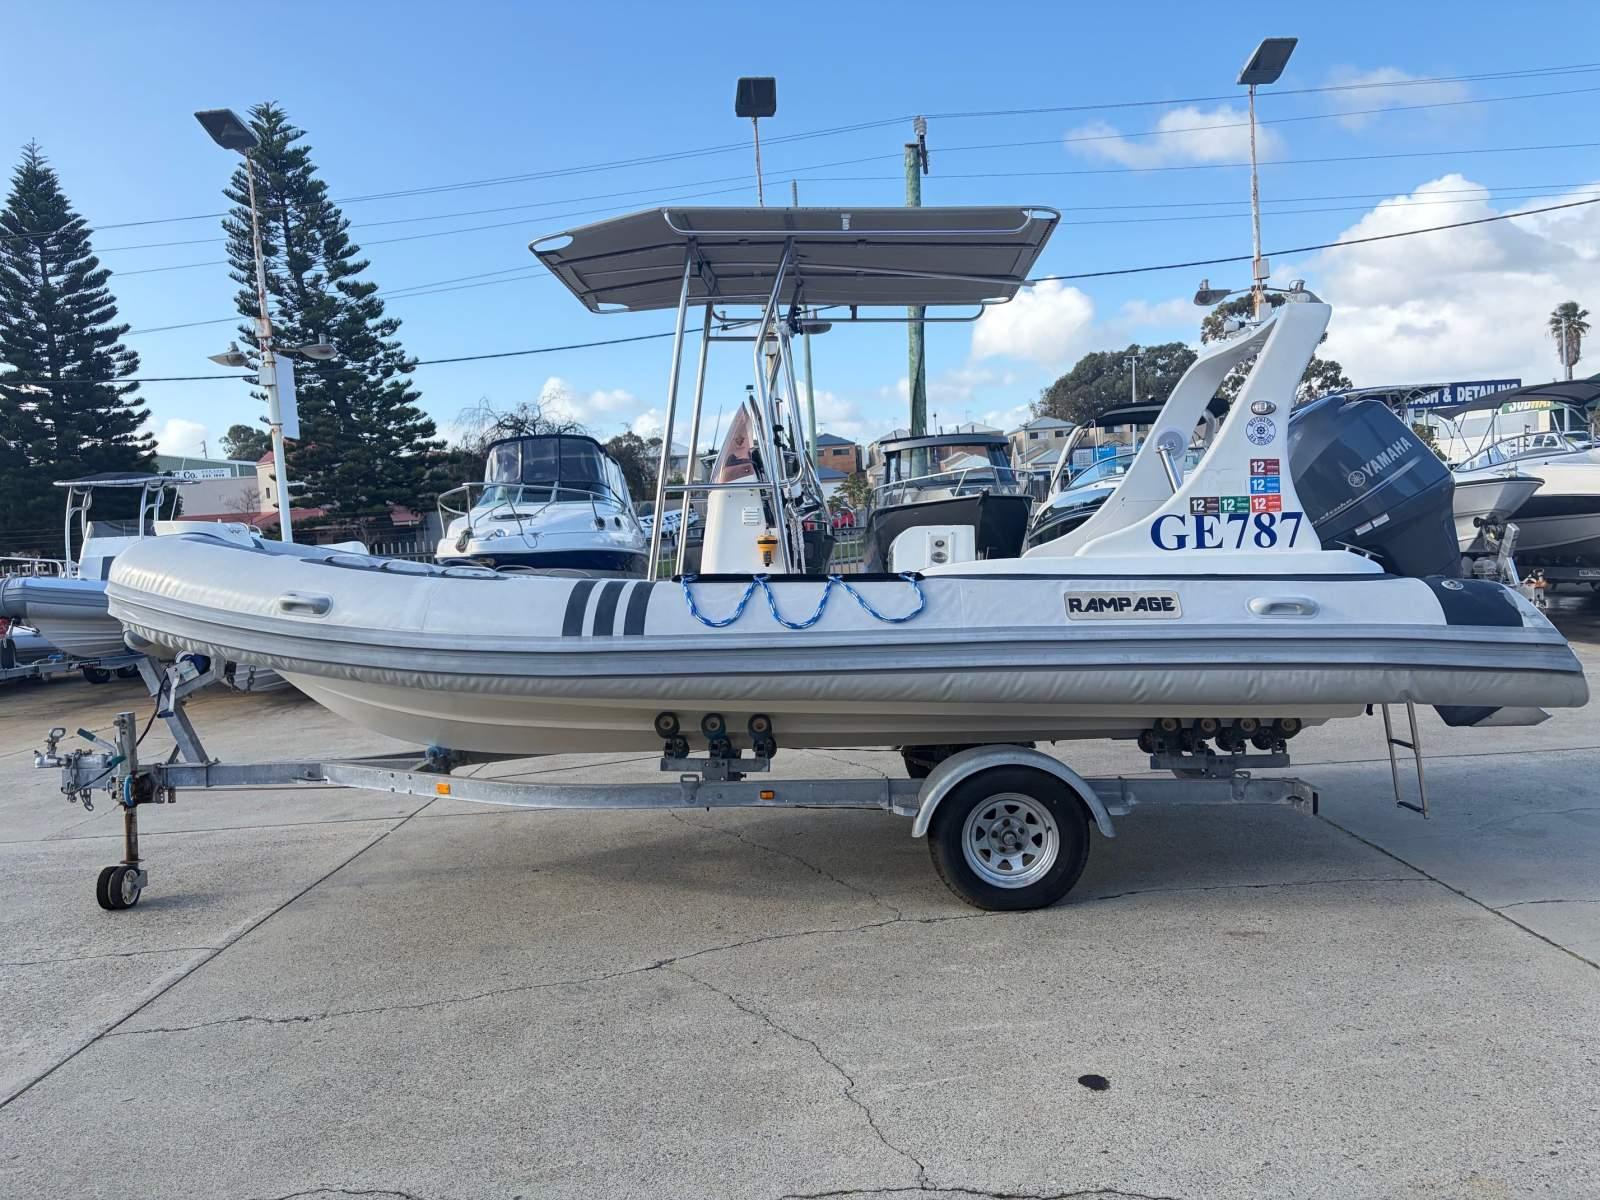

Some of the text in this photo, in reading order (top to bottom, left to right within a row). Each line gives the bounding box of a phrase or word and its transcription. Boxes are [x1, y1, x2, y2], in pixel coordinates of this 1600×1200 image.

[1442, 387, 1451, 402] &
[1361, 436, 1413, 477] YAMAHA
[1251, 461, 1265, 473] 12
[1251, 479, 1265, 491] 12
[1191, 499, 1205, 511] 12
[1222, 498, 1235, 511] 12
[1253, 497, 1267, 510] 12
[1150, 511, 1303, 551] GE787
[1067, 596, 1176, 613] RAMPAGE
